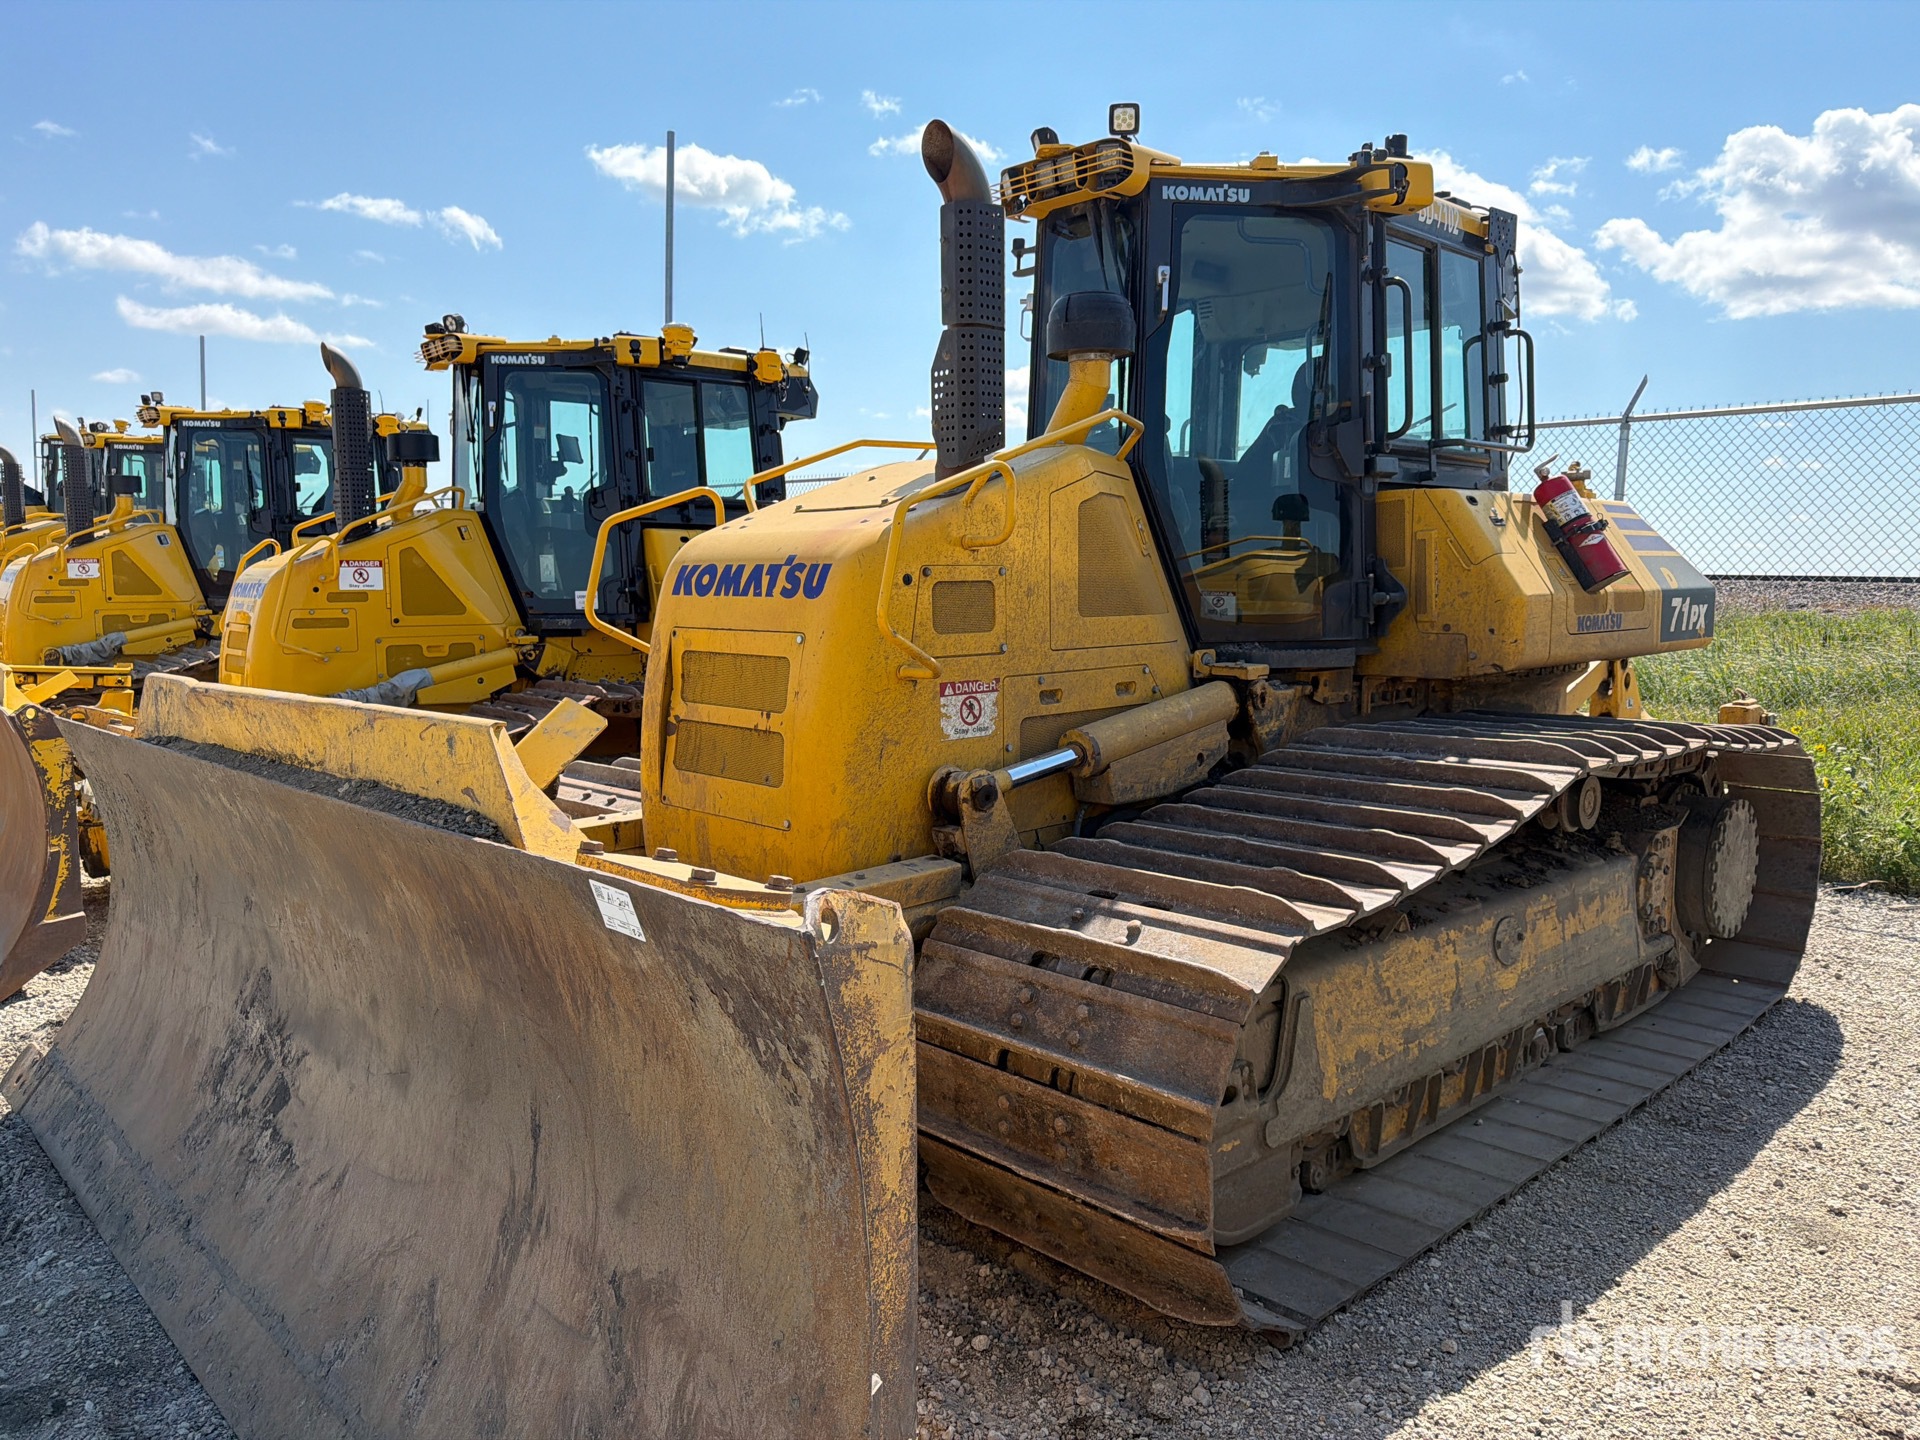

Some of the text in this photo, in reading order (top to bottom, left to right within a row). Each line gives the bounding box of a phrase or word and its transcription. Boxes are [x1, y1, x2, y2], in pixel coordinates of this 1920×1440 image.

[1162, 183, 1250, 203] KOMATSU
[491, 353, 546, 365] KOMATSU
[182, 419, 221, 428] KOMATSU
[113, 443, 144, 451] KOMATSU
[671, 554, 833, 600] KOMATSU
[1577, 609, 1623, 632] KOMATSU
[1669, 597, 1708, 633] 71PX
[955, 680, 997, 694] DANGER
[972, 725, 990, 733] clear
